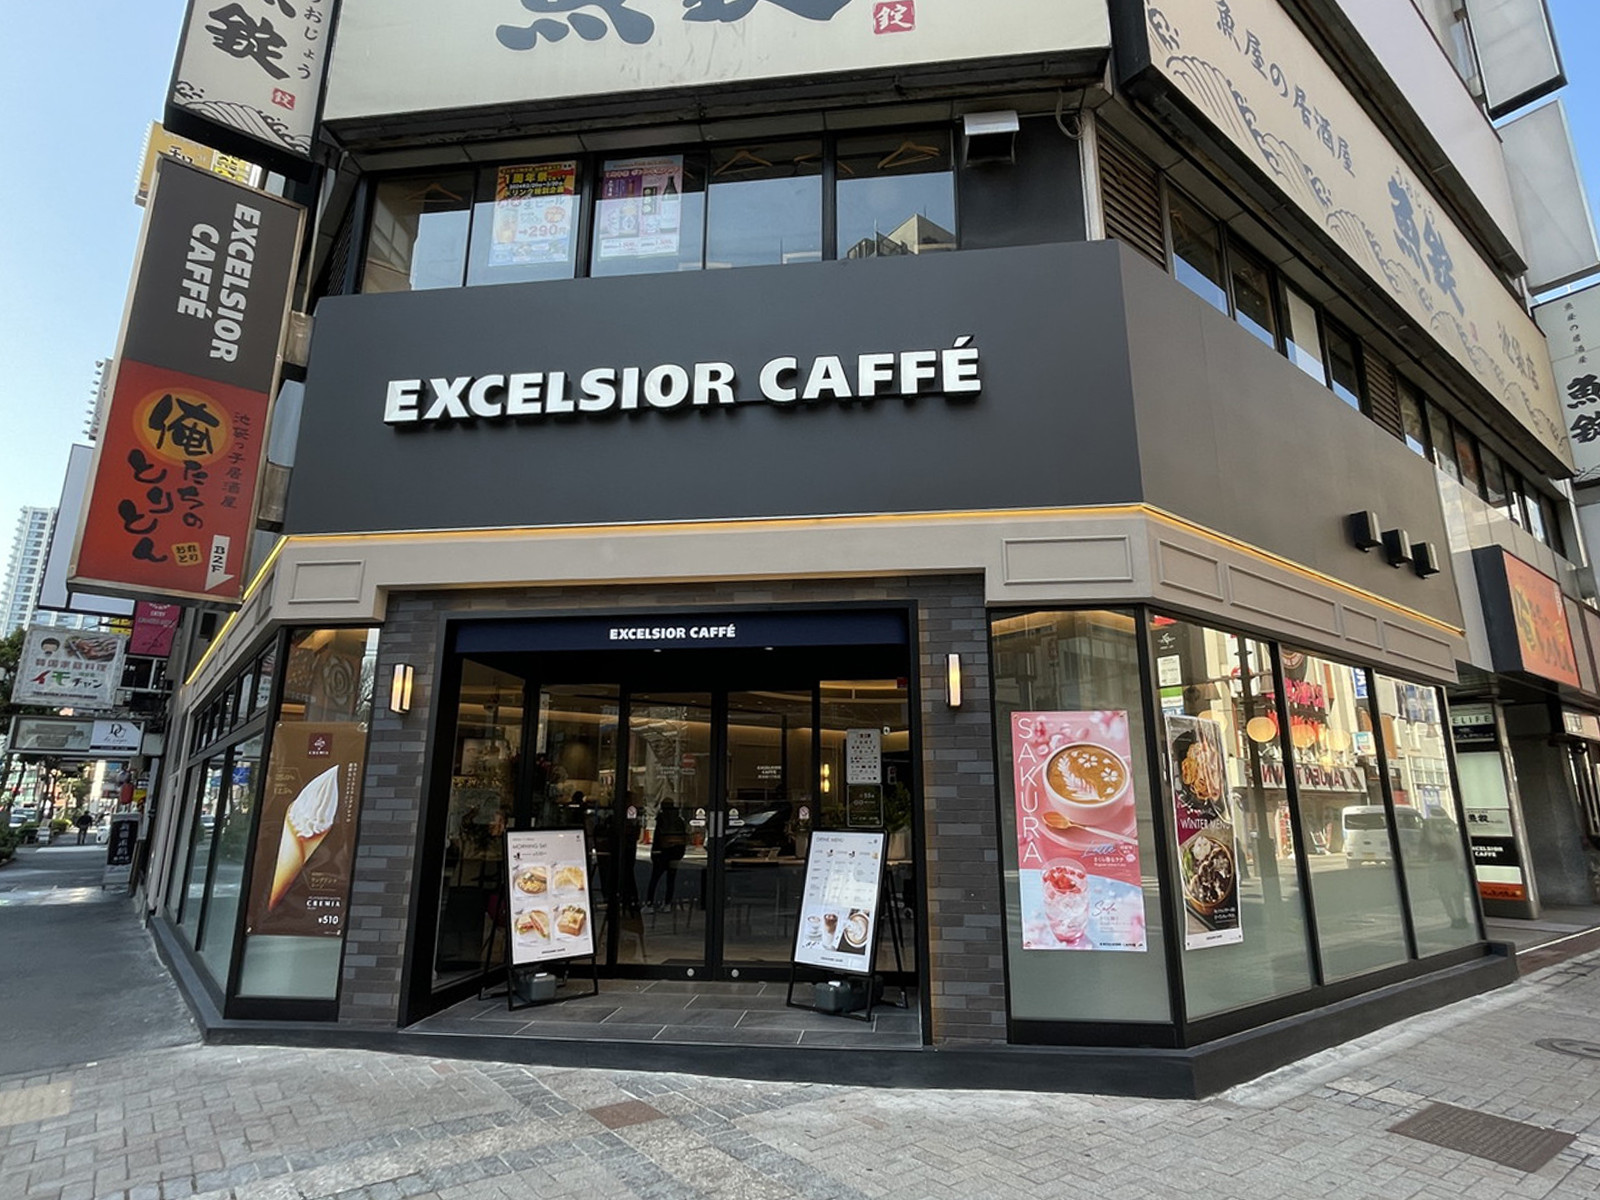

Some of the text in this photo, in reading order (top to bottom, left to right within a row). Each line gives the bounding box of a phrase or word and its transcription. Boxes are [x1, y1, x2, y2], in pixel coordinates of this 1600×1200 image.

[205, 0, 296, 80] 錠
[177, 223, 220, 319] CAFFÉ
[209, 203, 262, 363] EXCELSIOR
[383, 336, 982, 424] EXCELSIOR CAFFÉ
[118, 449, 175, 563] とりとん
[148, 393, 221, 529] 俺たちの
[609, 623, 736, 640] EXCELSIOR CAFFÉ
[1017, 718, 1044, 864] SAKURA
[1180, 818, 1209, 830] WINTER
